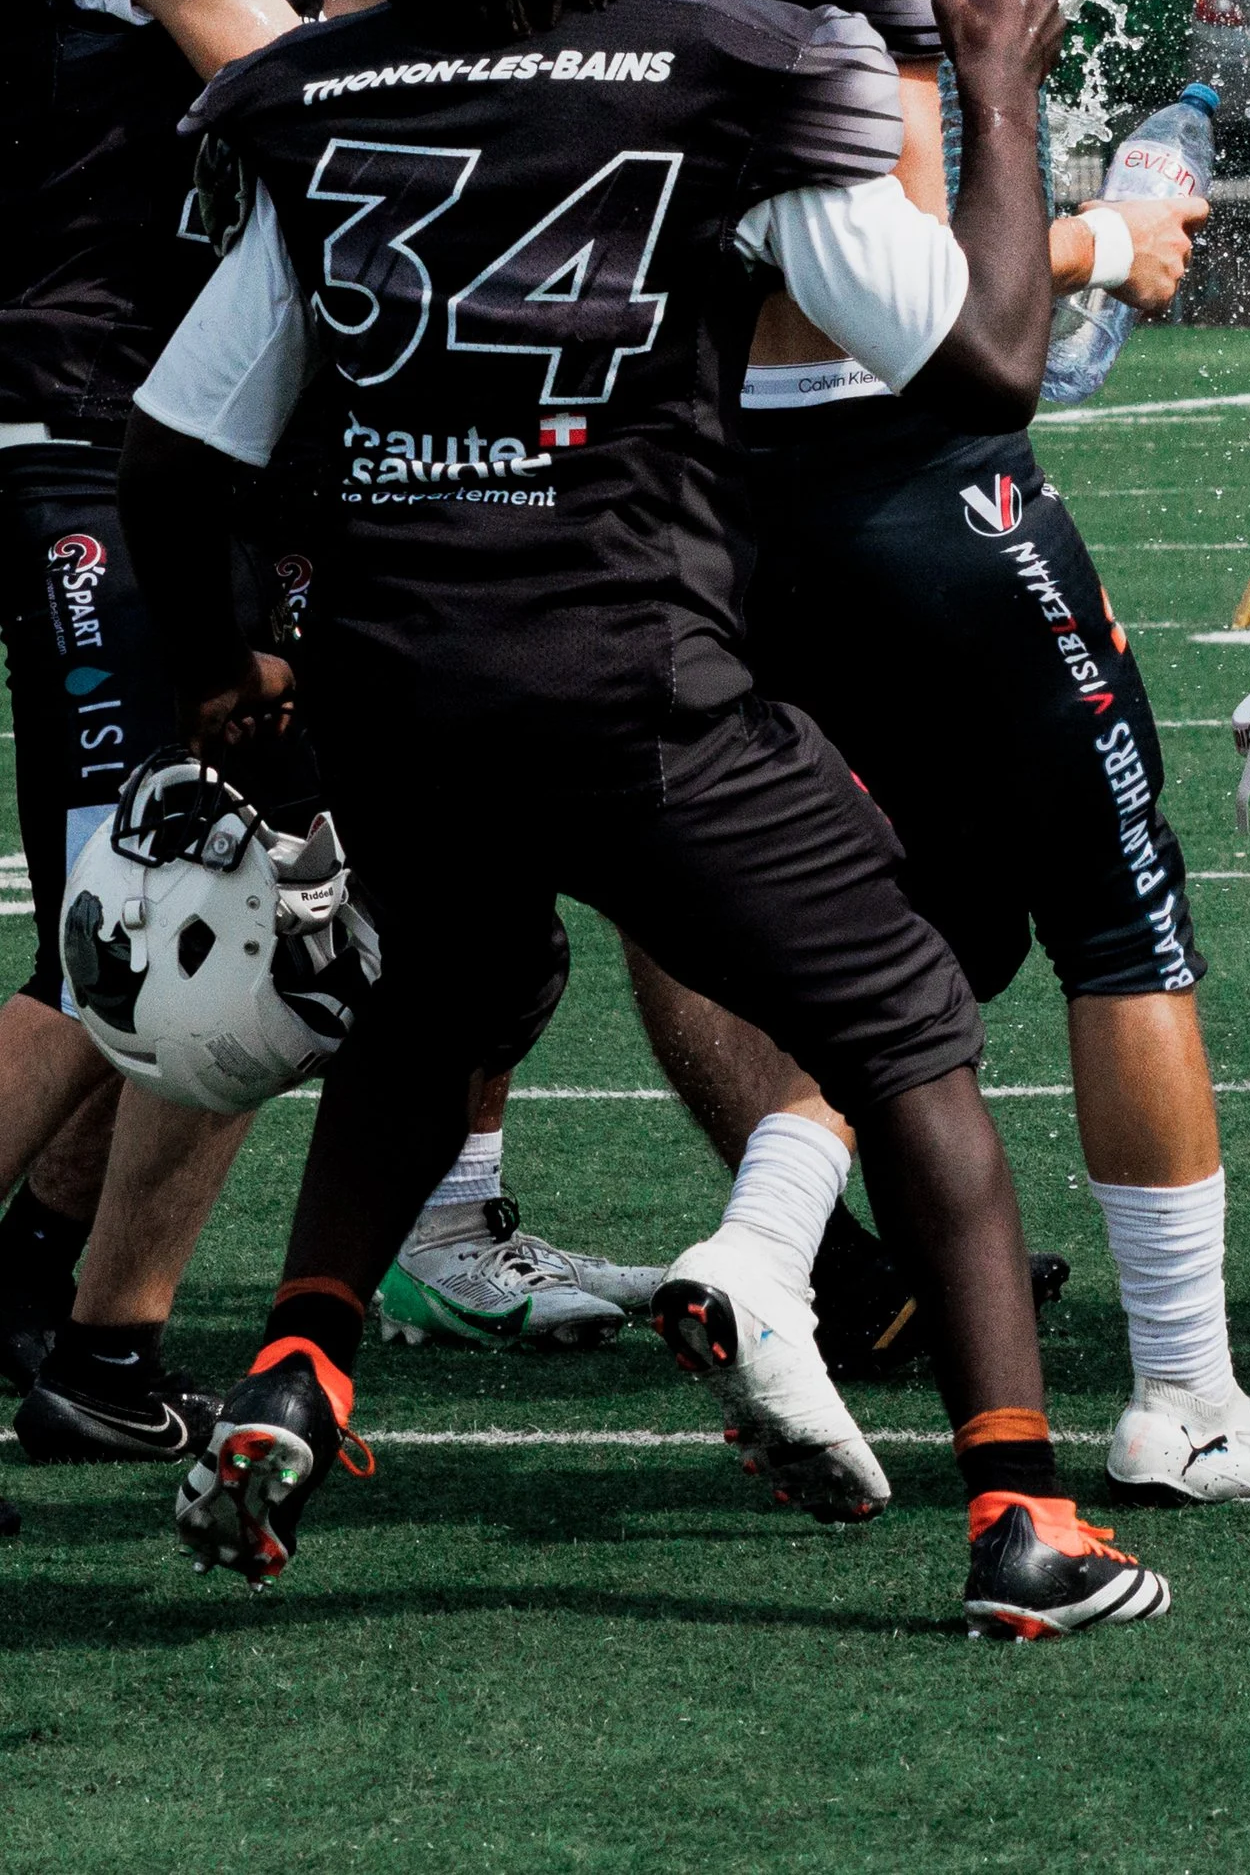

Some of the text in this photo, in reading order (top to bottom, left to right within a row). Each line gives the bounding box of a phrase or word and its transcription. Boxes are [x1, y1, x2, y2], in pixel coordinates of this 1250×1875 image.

[302, 49, 676, 105] THONON-LES-BAINS
[1124, 149, 1196, 197] evian
[306, 137, 684, 405] 34
[798, 373, 846, 394] Calvin
[78, 699, 124, 778] ISL
[1095, 720, 1166, 897] PANTHERS
